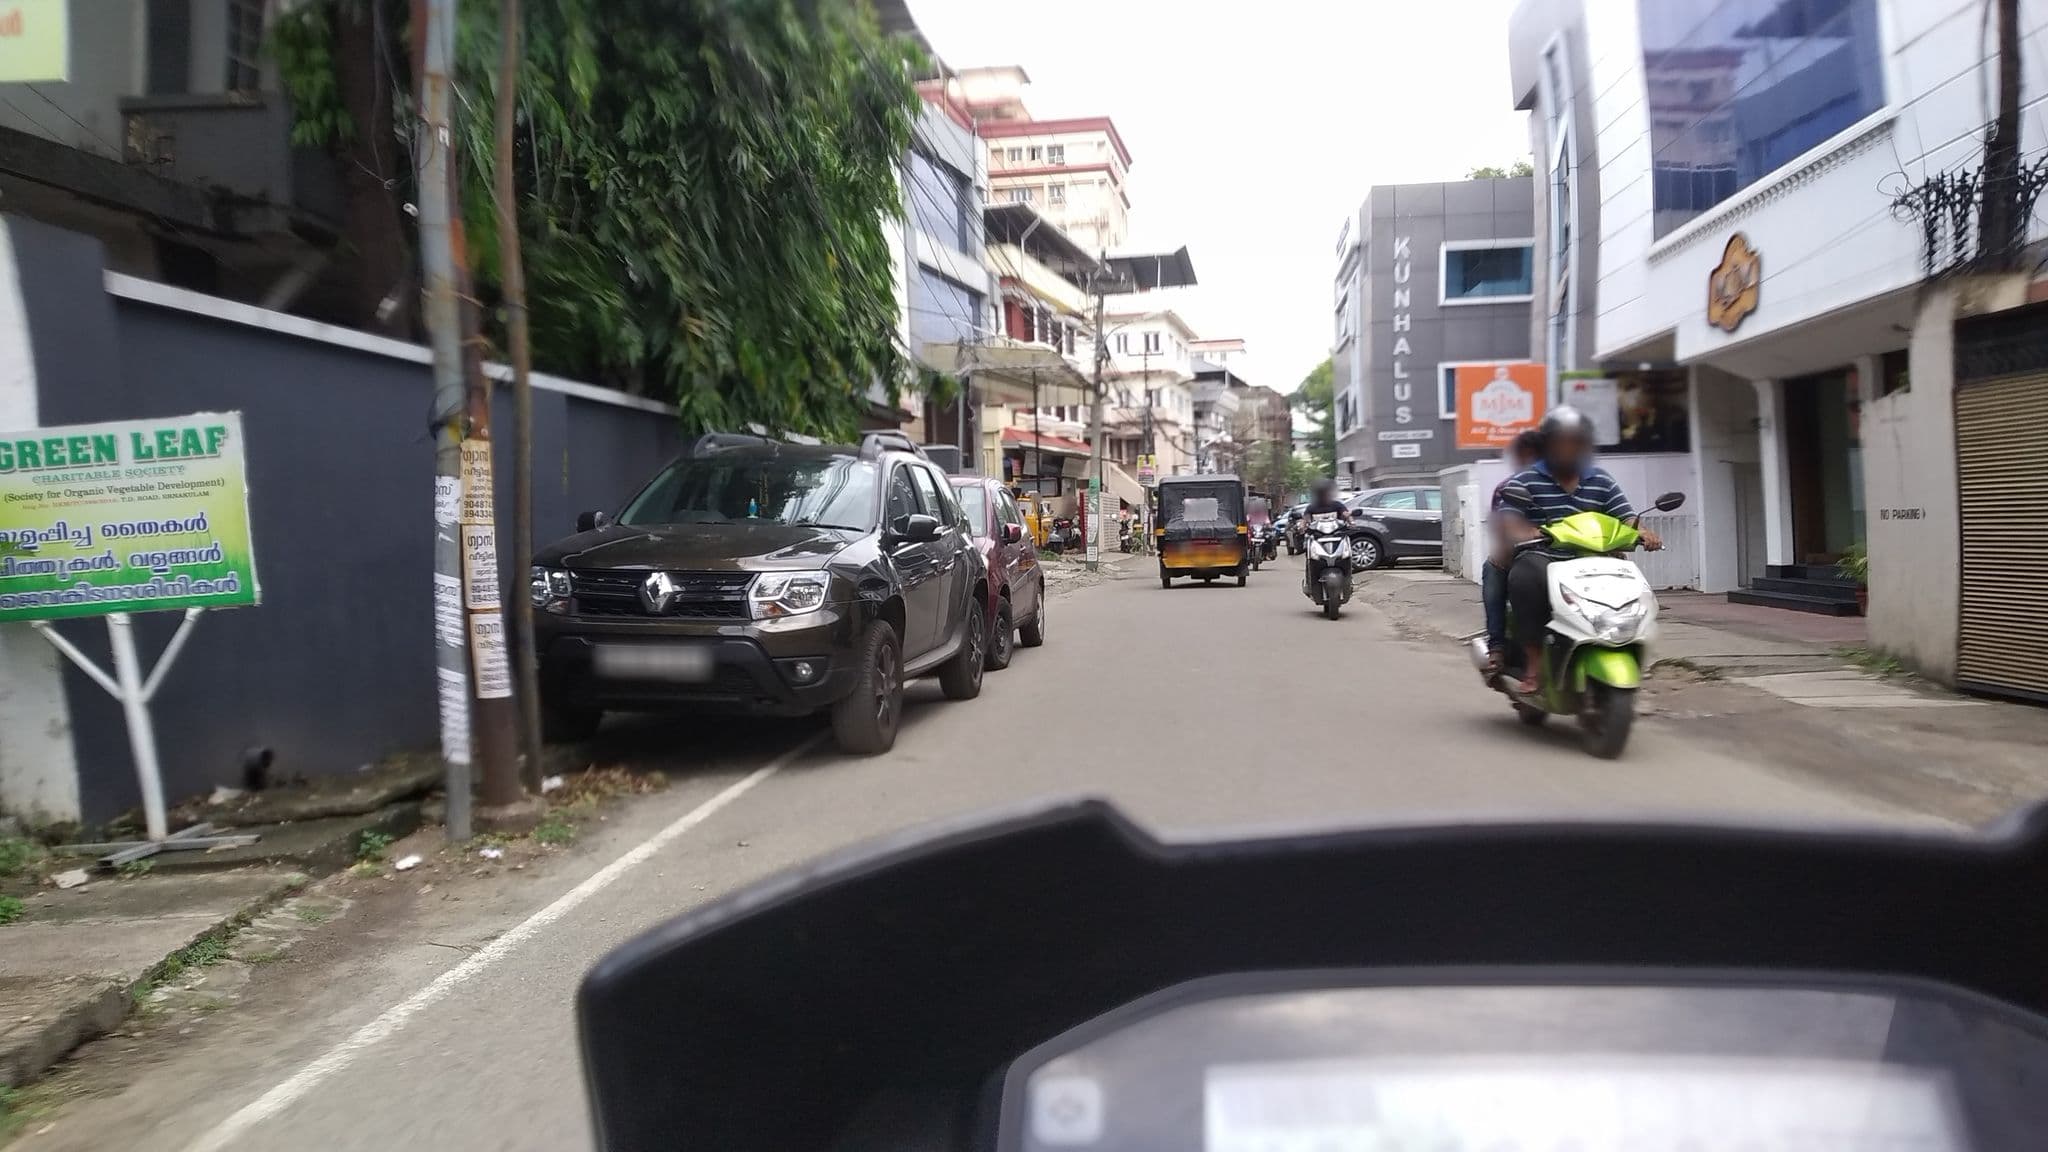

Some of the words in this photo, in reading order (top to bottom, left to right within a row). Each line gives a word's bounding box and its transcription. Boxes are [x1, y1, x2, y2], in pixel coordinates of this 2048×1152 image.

[1393, 236, 1412, 424] KUNHALUS
[130, 426, 226, 461] LEAF
[32, 469, 121, 484] CHARITABLE
[125, 464, 185, 478] SOCIETY
[4, 490, 43, 503] (Society
[47, 490, 61, 499] for
[64, 486, 104, 498] Organic
[107, 482, 155, 495] Vegetable
[157, 478, 225, 492] Development)
